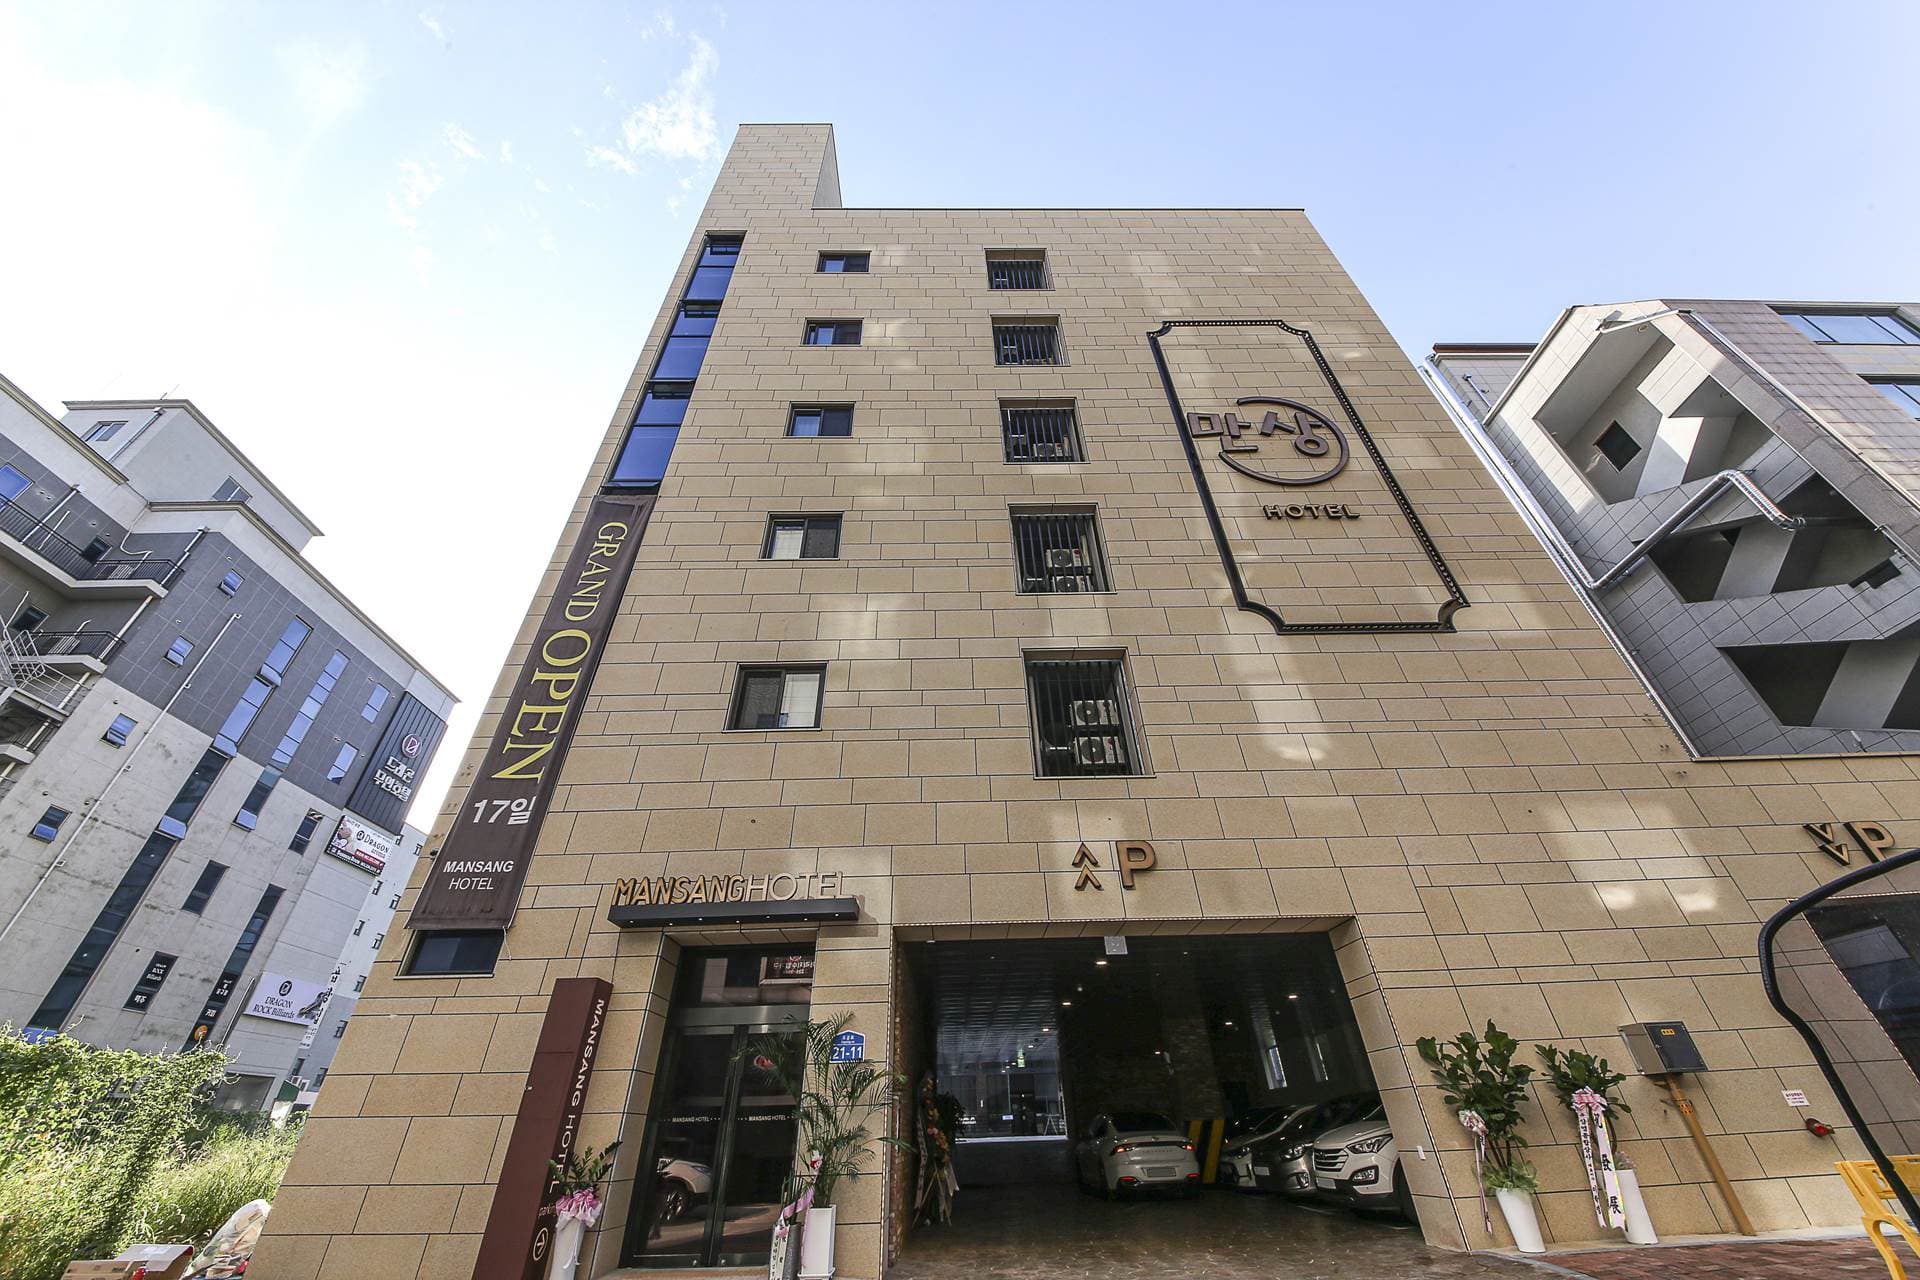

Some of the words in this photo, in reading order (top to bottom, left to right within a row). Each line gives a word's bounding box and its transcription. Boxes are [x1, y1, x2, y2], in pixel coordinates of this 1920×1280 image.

[1187, 411, 1330, 456] 만상
[1263, 504, 1360, 520] HOTEL
[564, 520, 628, 622] GRAND
[491, 629, 592, 784] OPEN
[472, 797, 536, 825] 17일
[1845, 821, 1895, 863] P
[443, 859, 514, 874] MANSANG
[1115, 840, 1157, 890] P
[449, 877, 495, 891] HOTEL
[253, 1003, 273, 1014] ROCK
[271, 1007, 296, 1019] Billiards
[265, 996, 294, 1009] DRAGON
[569, 999, 606, 1107] MANSANG
[832, 1046, 863, 1060] 21-11
